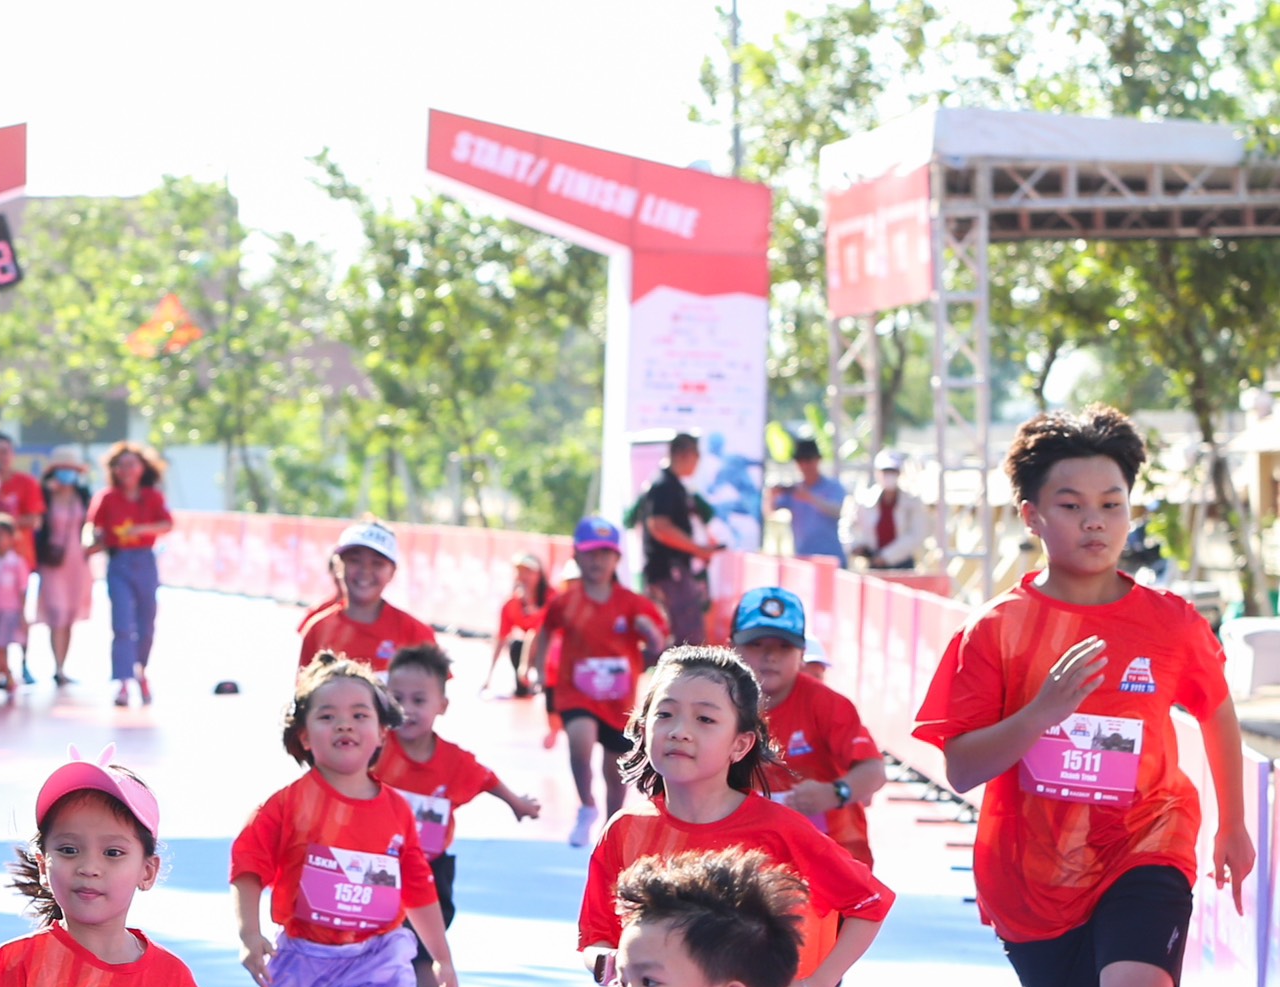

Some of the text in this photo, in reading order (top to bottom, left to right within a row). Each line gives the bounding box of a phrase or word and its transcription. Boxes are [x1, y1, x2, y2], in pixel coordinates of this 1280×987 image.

[547, 163, 639, 218] FINISH
[639, 193, 700, 239] LINE
[1062, 750, 1102, 772] 1511
[334, 882, 373, 905] 1528
